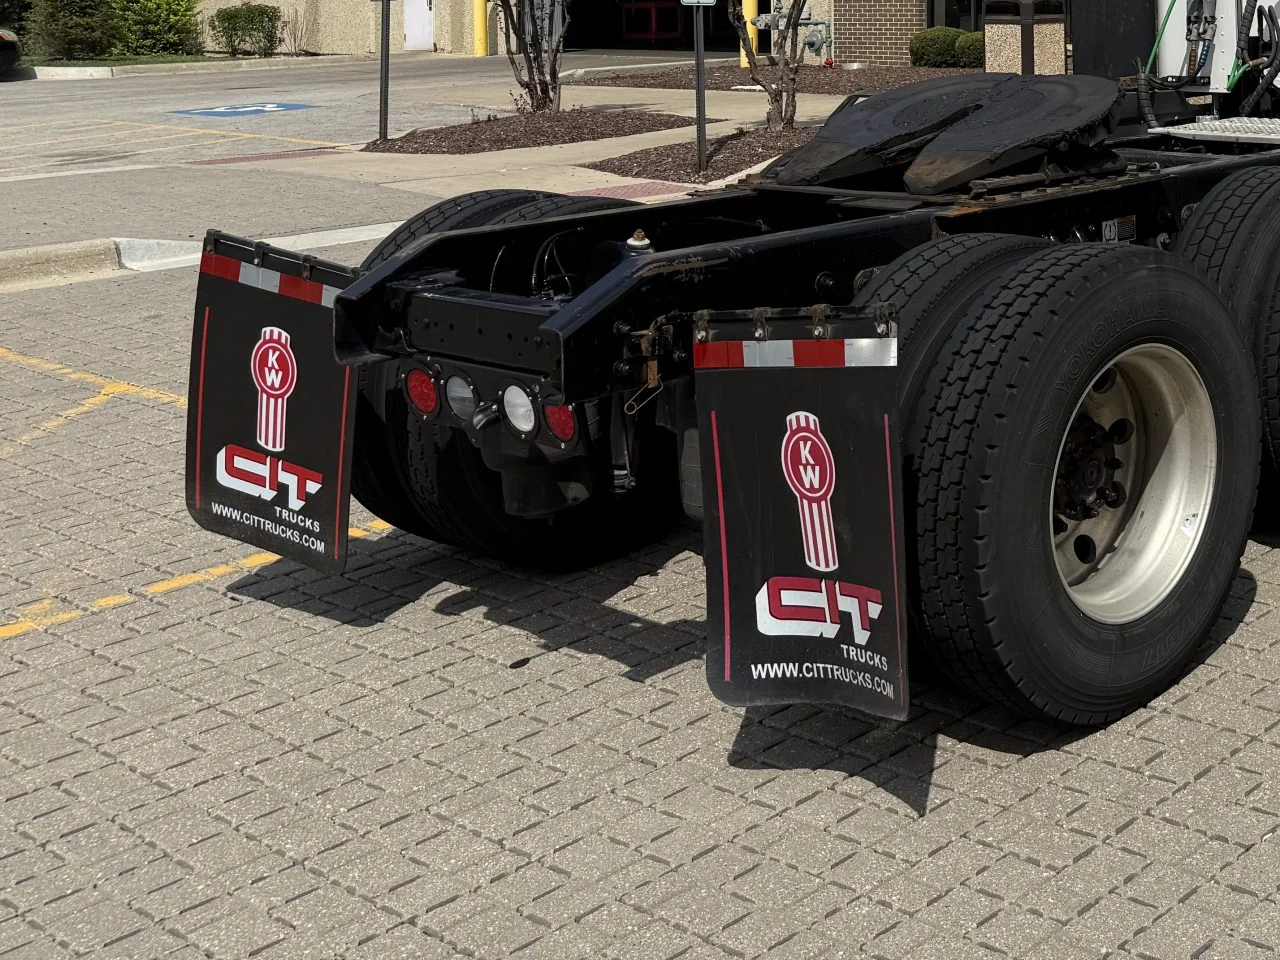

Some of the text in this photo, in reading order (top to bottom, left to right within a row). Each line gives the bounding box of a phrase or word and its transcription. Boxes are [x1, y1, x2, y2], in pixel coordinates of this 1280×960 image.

[1055, 293, 1169, 395] YOKOHAMA
[216, 444, 323, 511] CIT
[211, 501, 325, 553] WWW.CITTRUCKS.COM
[274, 506, 321, 532] TRUCKS
[755, 576, 883, 646] CIT
[751, 662, 894, 700] WWW.CITTRUCKS.COM
[840, 644, 888, 671] TRUCKS
